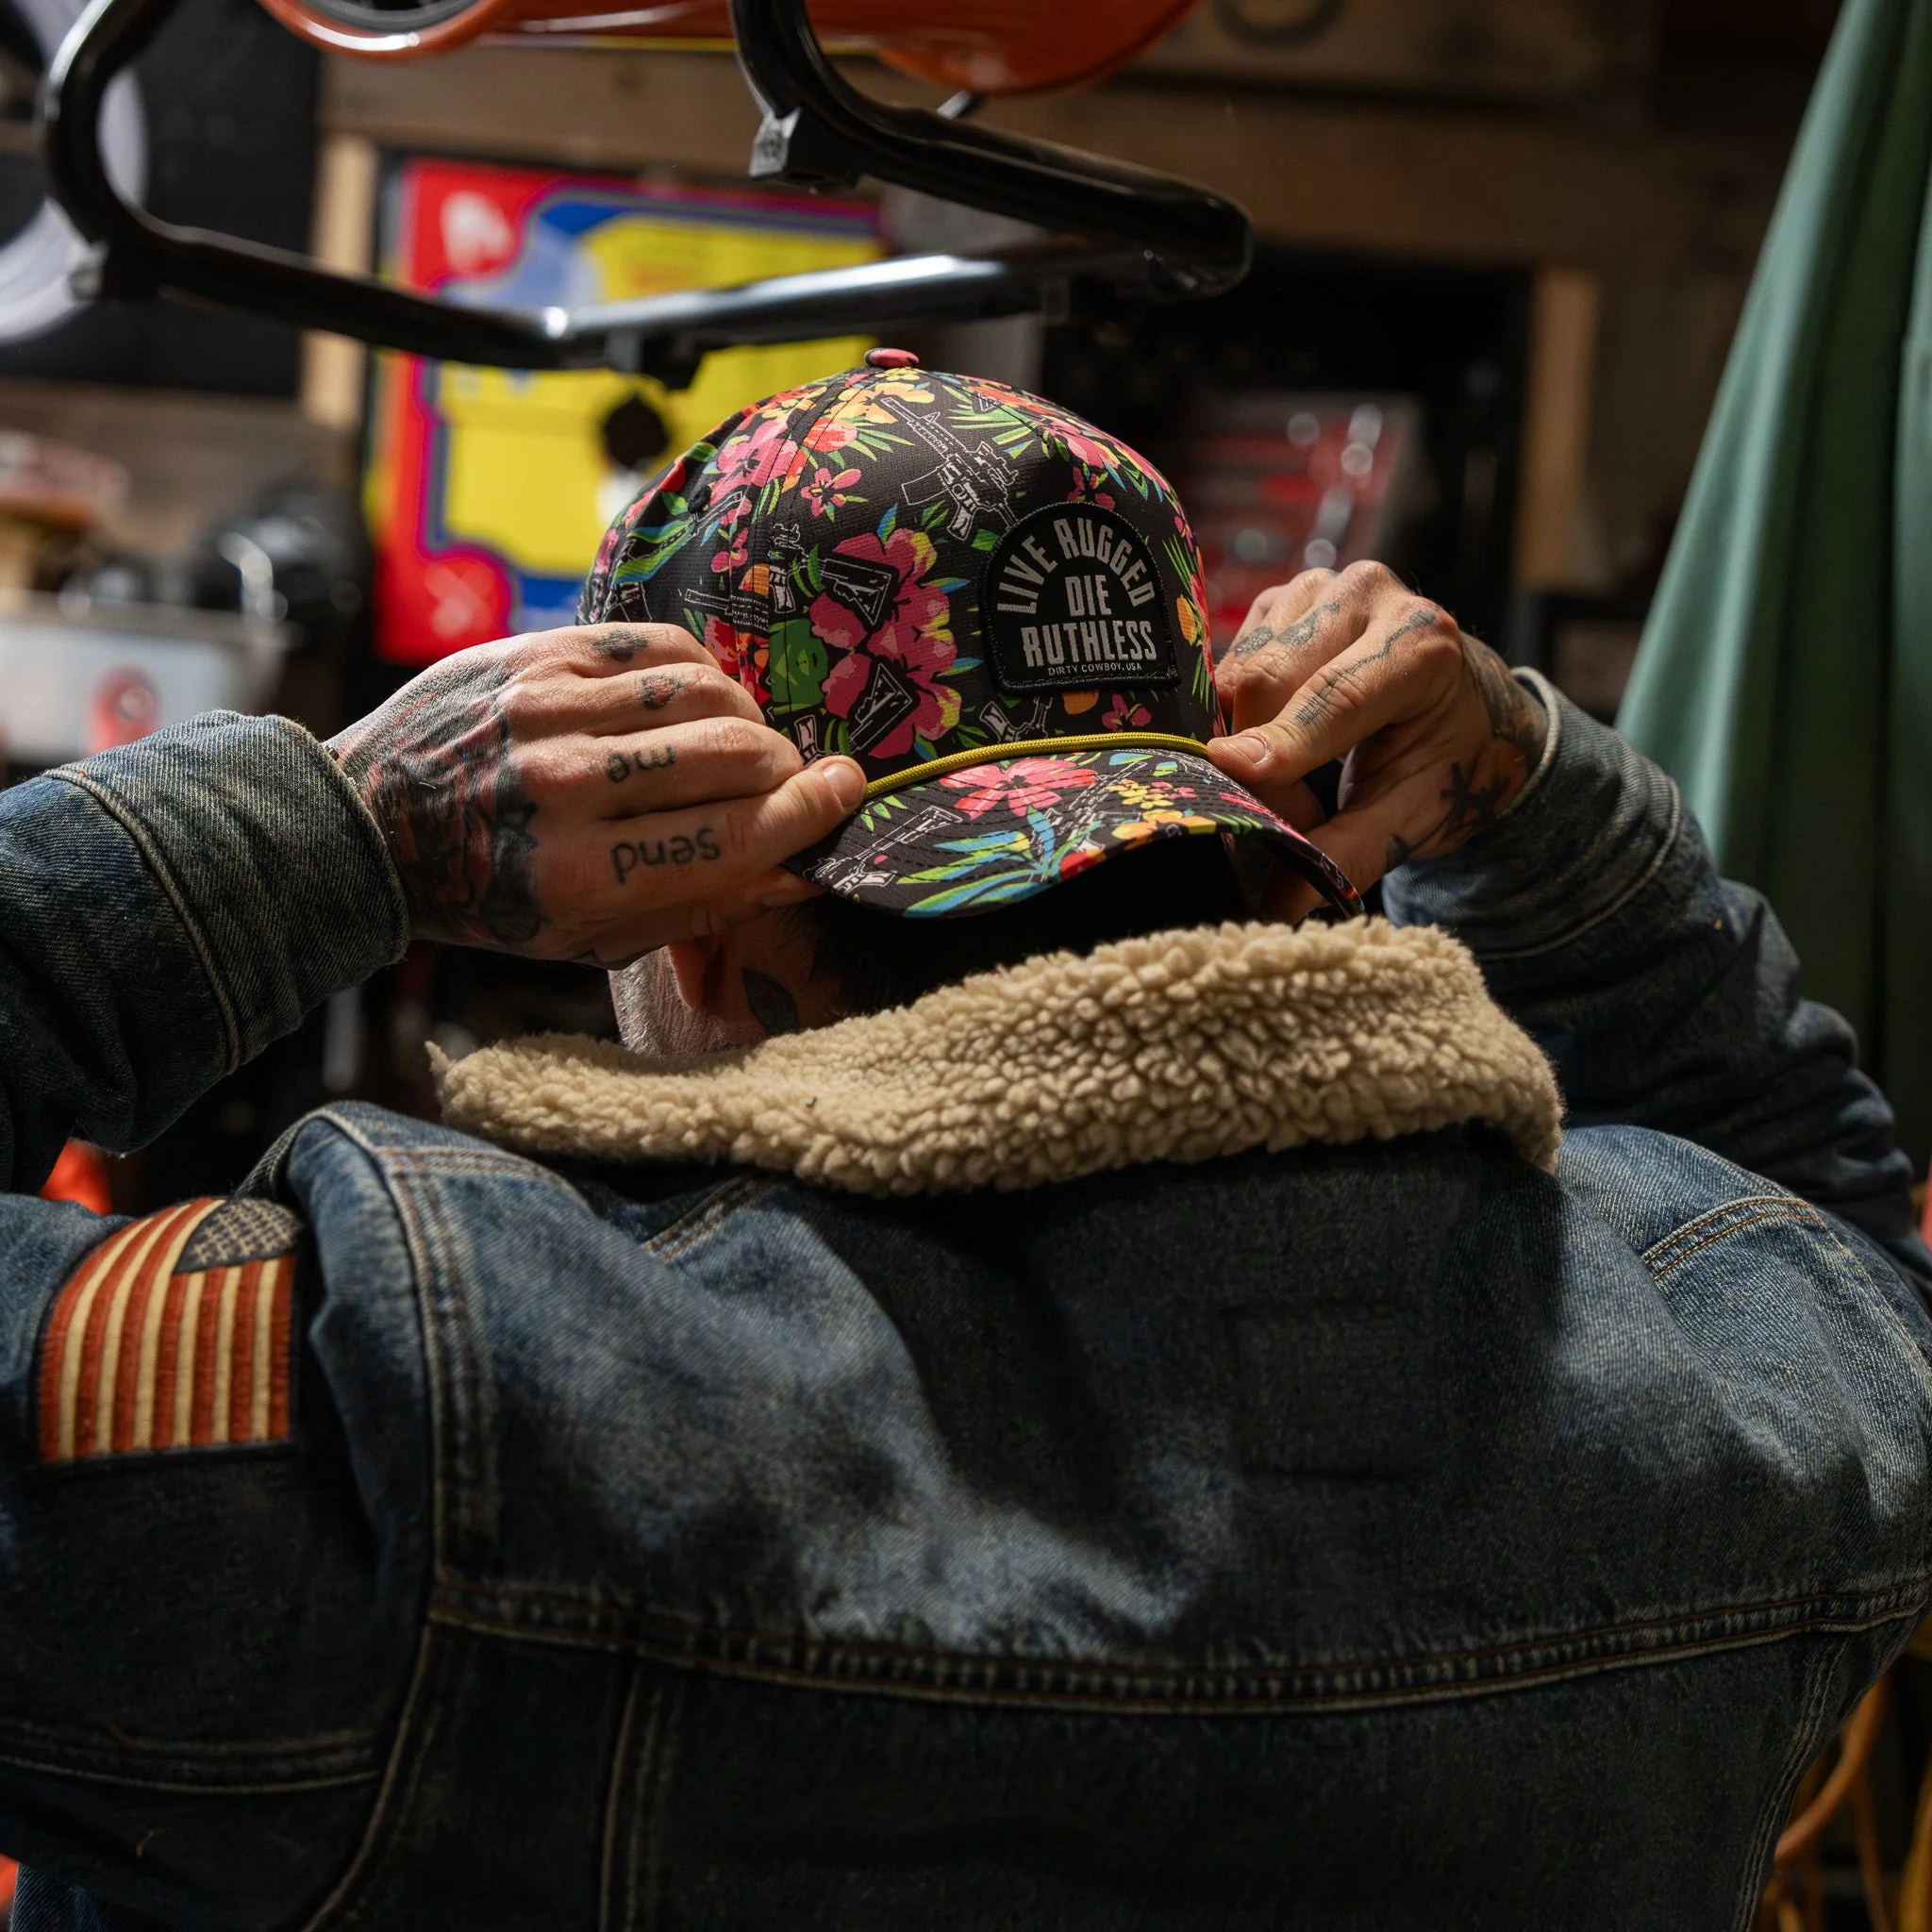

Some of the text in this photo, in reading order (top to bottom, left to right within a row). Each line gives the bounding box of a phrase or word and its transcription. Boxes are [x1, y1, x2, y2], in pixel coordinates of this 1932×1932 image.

[997, 517, 1156, 614] LIVE RUGGED
[1064, 575, 1112, 616] DIE
[1021, 620, 1158, 667] RUTHLESS
[1047, 665, 1077, 675] DIRTY
[607, 745, 675, 783] me
[609, 828, 722, 884] send
